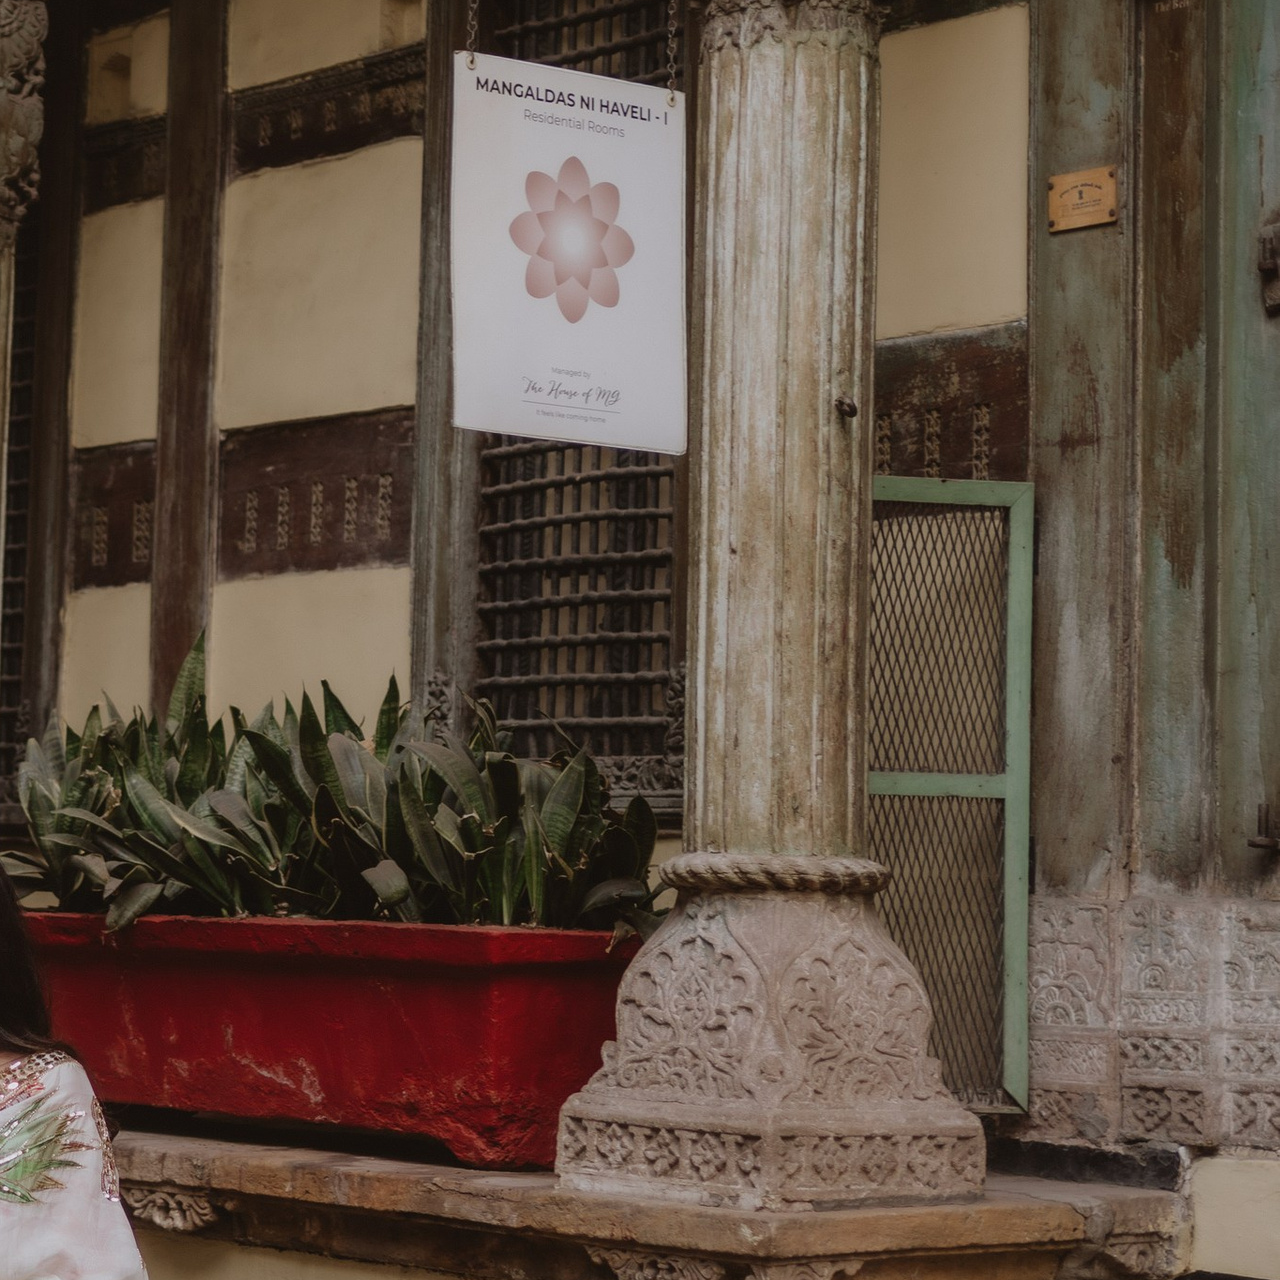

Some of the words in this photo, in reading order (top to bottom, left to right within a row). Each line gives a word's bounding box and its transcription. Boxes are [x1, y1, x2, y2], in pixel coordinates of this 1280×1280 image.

[1153, 1, 1171, 13] The
[475, 76, 576, 108] MANGALDAS
[580, 95, 595, 112] NI
[600, 99, 651, 122] HAVELI
[523, 108, 585, 131] Residential
[588, 120, 626, 139] Rooms
[551, 366, 582, 378] Managed
[583, 370, 592, 380] by
[521, 376, 545, 394] The
[547, 380, 580, 400] House
[582, 388, 593, 404] of
[595, 386, 621, 407] MG
